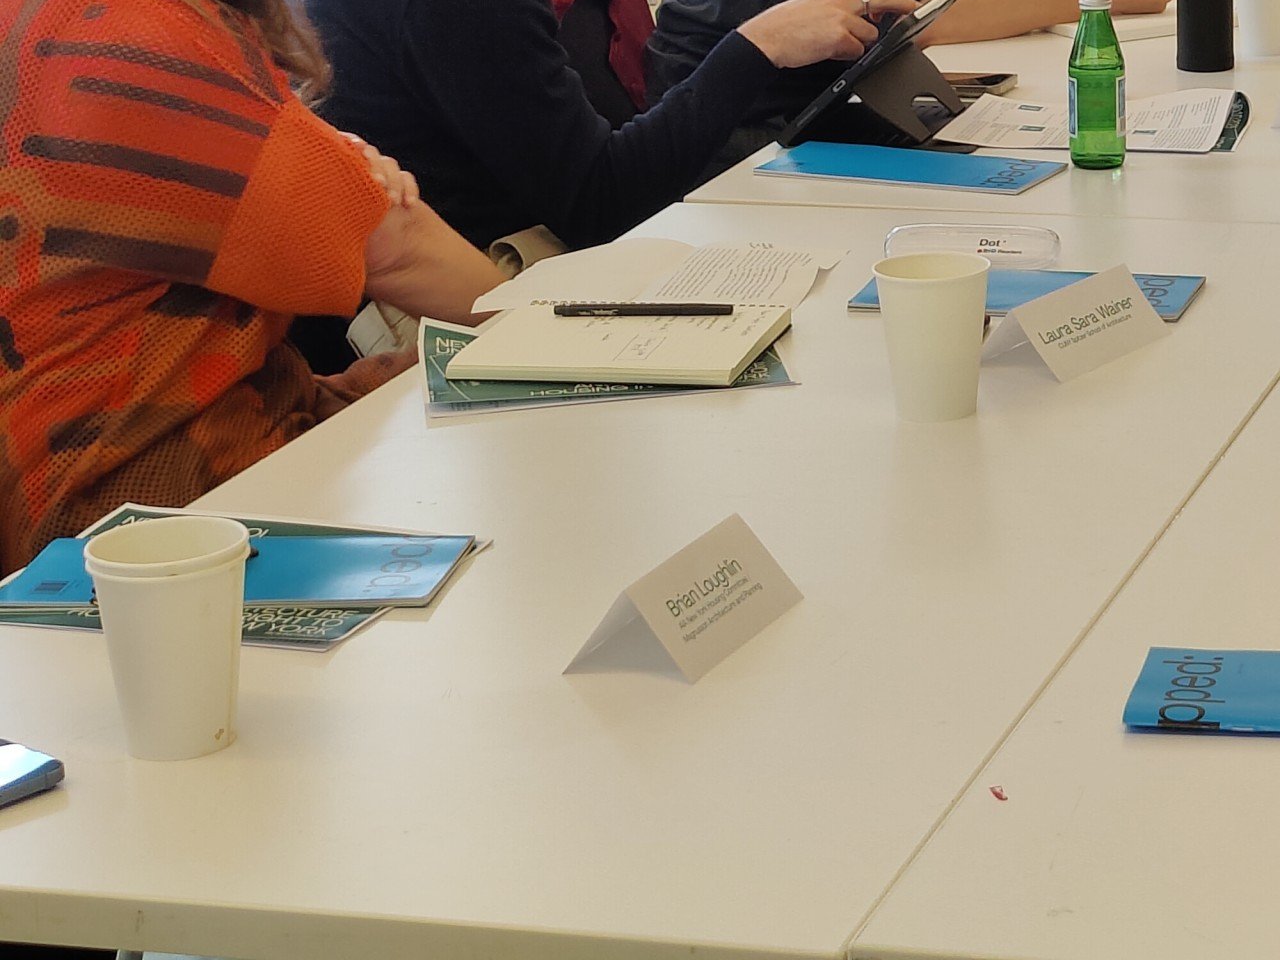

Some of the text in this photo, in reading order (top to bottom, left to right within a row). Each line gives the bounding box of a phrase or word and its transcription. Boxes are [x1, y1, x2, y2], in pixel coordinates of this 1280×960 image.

[979, 238, 1000, 247] Dot
[1038, 296, 1133, 345] Laura Sara Wainer
[665, 559, 743, 617] Brian Loughlin
[270, 622, 336, 636] YORK
